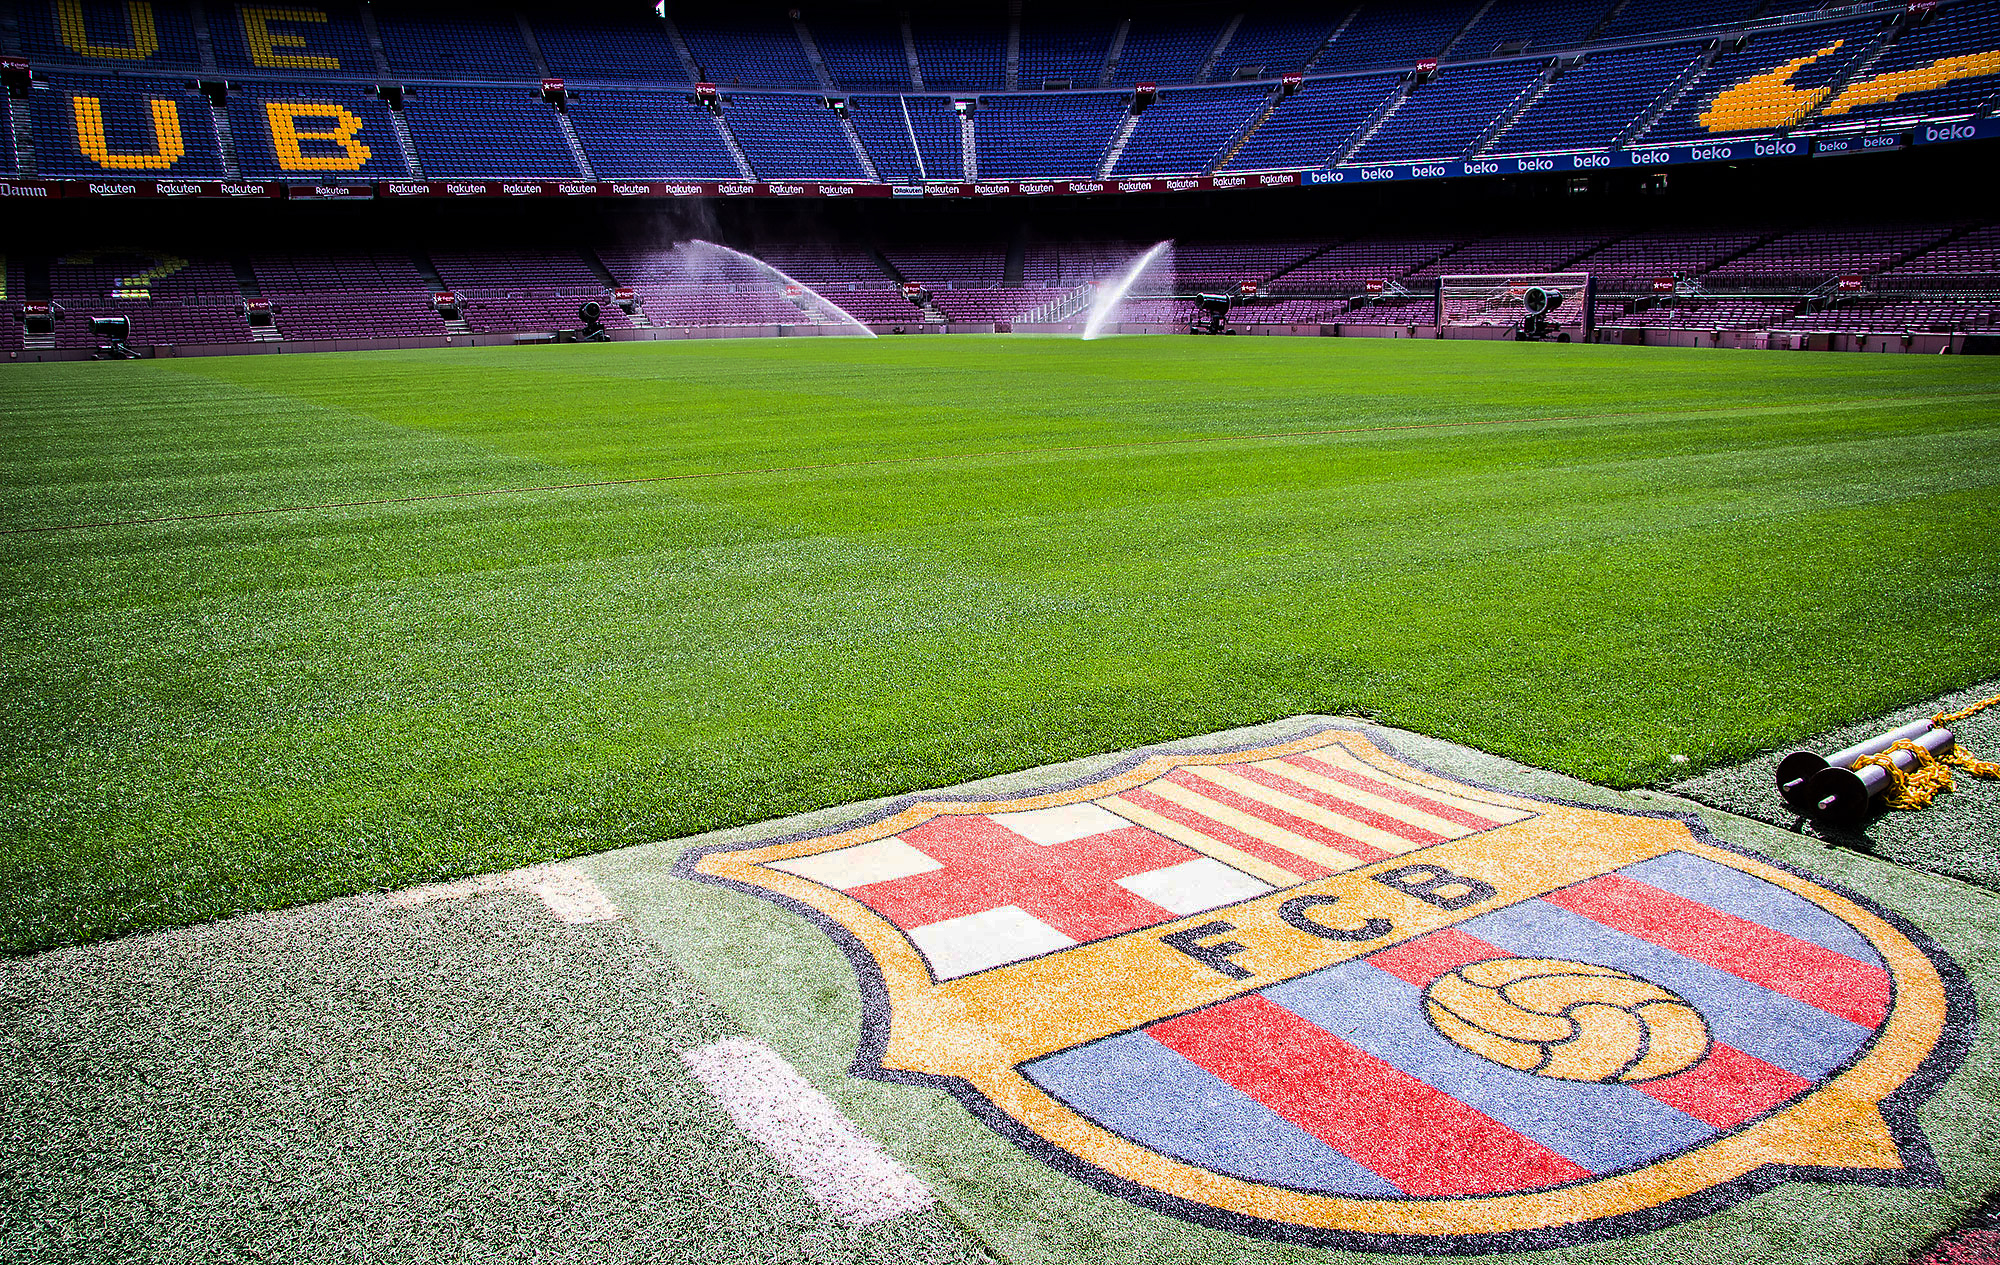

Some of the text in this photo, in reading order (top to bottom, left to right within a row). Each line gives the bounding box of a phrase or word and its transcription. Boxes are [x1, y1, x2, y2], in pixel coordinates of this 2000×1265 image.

[1925, 124, 1976, 142] beko
[1755, 141, 1796, 155] beko
[1818, 141, 1848, 151] beko
[1863, 136, 1894, 148] beko
[1631, 150, 1670, 164] beko
[1691, 146, 1732, 161] beko
[1517, 158, 1554, 172] beko
[1574, 154, 1611, 168] beko
[1361, 168, 1394, 181] beko
[1411, 164, 1446, 178] beko
[1463, 161, 1499, 175] beko
[1213, 176, 1245, 189] Rakuten
[1260, 174, 1293, 187] Rakuten
[1311, 171, 1344, 184] beko
[0, 183, 47, 197] Damm
[89, 183, 136, 195] Rakuten
[156, 183, 201, 195] Rakuten
[221, 183, 264, 195] Rakuten
[315, 185, 349, 196] Rakuten
[389, 183, 429, 196] Rakuten
[447, 183, 486, 196] Rakuten
[503, 183, 541, 196] Rakuten
[559, 183, 596, 196] Rakuten
[612, 184, 649, 196] Rakuten
[666, 184, 702, 196] Rakuten
[719, 184, 753, 196] Rakuten
[769, 184, 803, 196] Rakuten
[820, 185, 853, 196] Rakuten
[924, 184, 959, 195] Rakuten
[975, 184, 1009, 195] Rakuten
[1020, 183, 1053, 194] Rakuten
[1069, 182, 1103, 194] Rakuten
[1119, 181, 1151, 193] Rakuten
[1167, 179, 1199, 192] Rakuten
[1159, 864, 1498, 981] FCB
